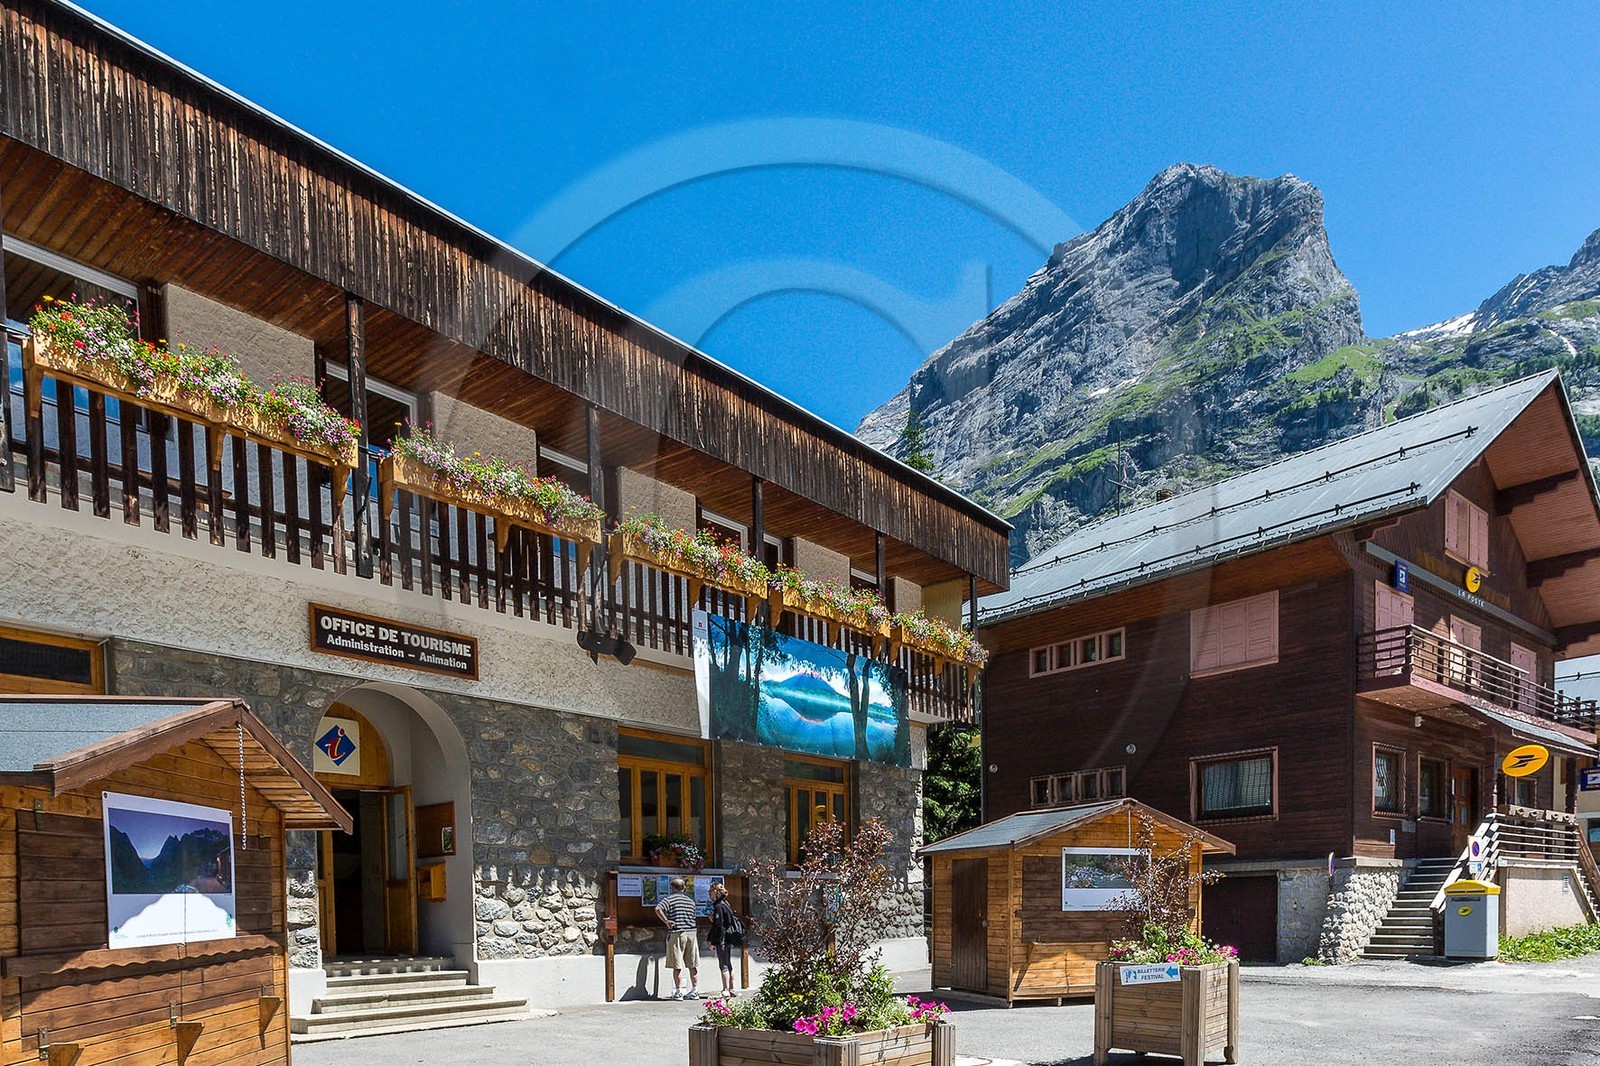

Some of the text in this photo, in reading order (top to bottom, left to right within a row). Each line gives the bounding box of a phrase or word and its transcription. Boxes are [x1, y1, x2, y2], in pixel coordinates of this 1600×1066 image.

[320, 615, 472, 657] OFFICE DE TOURISME
[326, 634, 405, 658] Administration
[419, 651, 467, 670] Animation
